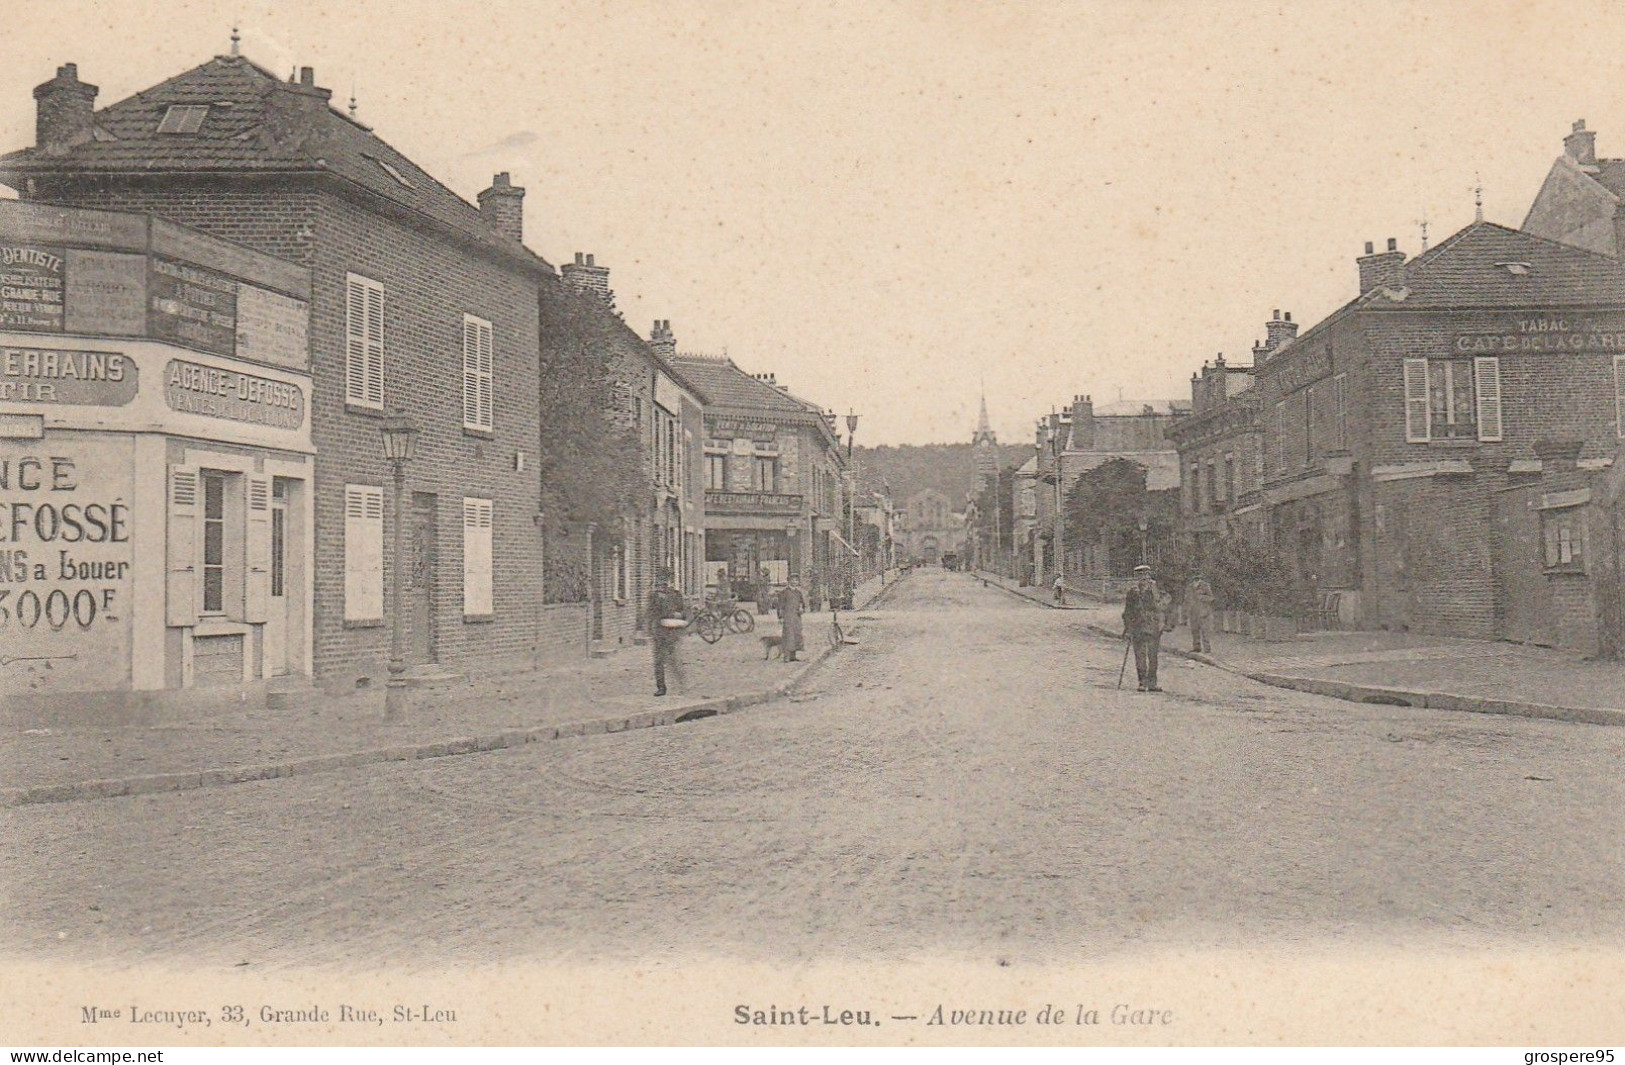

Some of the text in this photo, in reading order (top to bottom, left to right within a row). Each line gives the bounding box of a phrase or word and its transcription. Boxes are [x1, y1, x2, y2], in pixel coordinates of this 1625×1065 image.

[1518, 319, 1569, 333] TABAC
[34, 563, 46, 581] a
[58, 550, 129, 580] Louer
